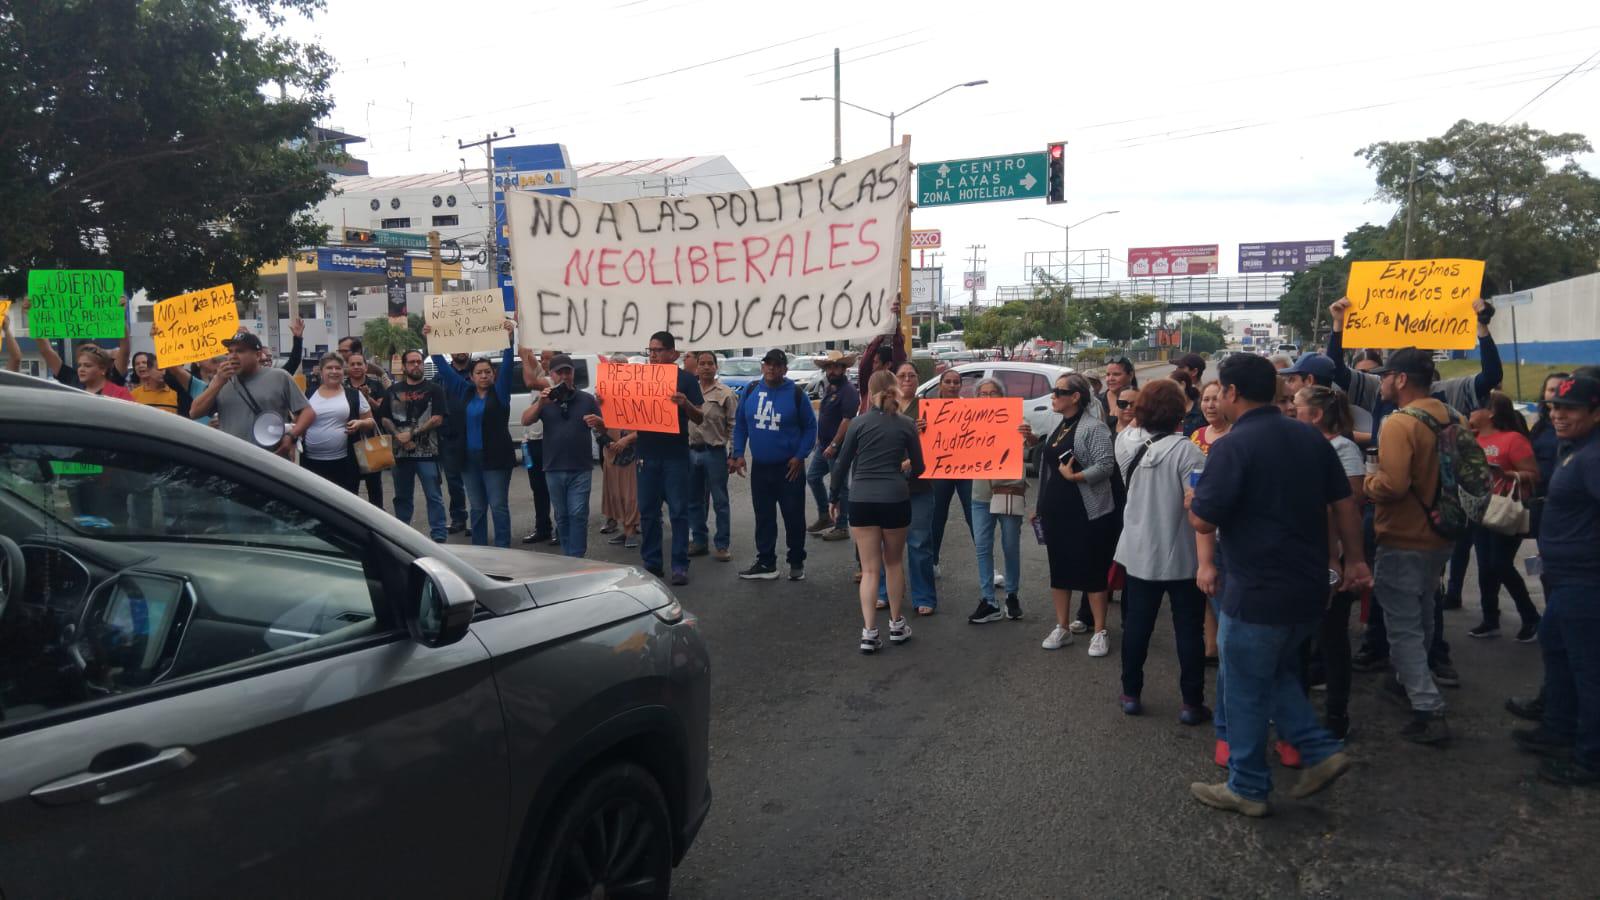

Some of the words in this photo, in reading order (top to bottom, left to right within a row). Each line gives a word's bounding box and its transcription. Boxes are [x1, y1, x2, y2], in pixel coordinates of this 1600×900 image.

[960, 158, 1026, 174] CENTRO
[935, 173, 1001, 189] PLAYAS
[530, 197, 580, 238] NO
[595, 202, 622, 241] A
[633, 199, 699, 233] LAS
[706, 159, 899, 229] POLITICAS
[923, 192, 951, 203] ZONA
[959, 185, 1015, 200] HOTELERA
[564, 218, 881, 286] NEOLIBERALES
[1380, 261, 1460, 286] Exigimos
[432, 297, 448, 309] EL
[451, 294, 494, 307] SALARIO
[1451, 286, 1471, 300] en
[158, 303, 176, 322] NO
[432, 310, 446, 320] NO
[449, 308, 464, 317] SE
[466, 305, 487, 314] TOCA
[537, 289, 588, 336] EN
[601, 300, 639, 337] LA
[665, 280, 885, 343] EDUCACIÓN
[455, 316, 470, 328] NO
[1394, 310, 1471, 335] Medicina
[191, 332, 218, 351] UAS
[607, 363, 666, 382] RESPETO
[599, 381, 607, 395] A
[612, 381, 631, 397] LAS
[636, 381, 675, 398] PLAZAS
[754, 391, 781, 431] LA
